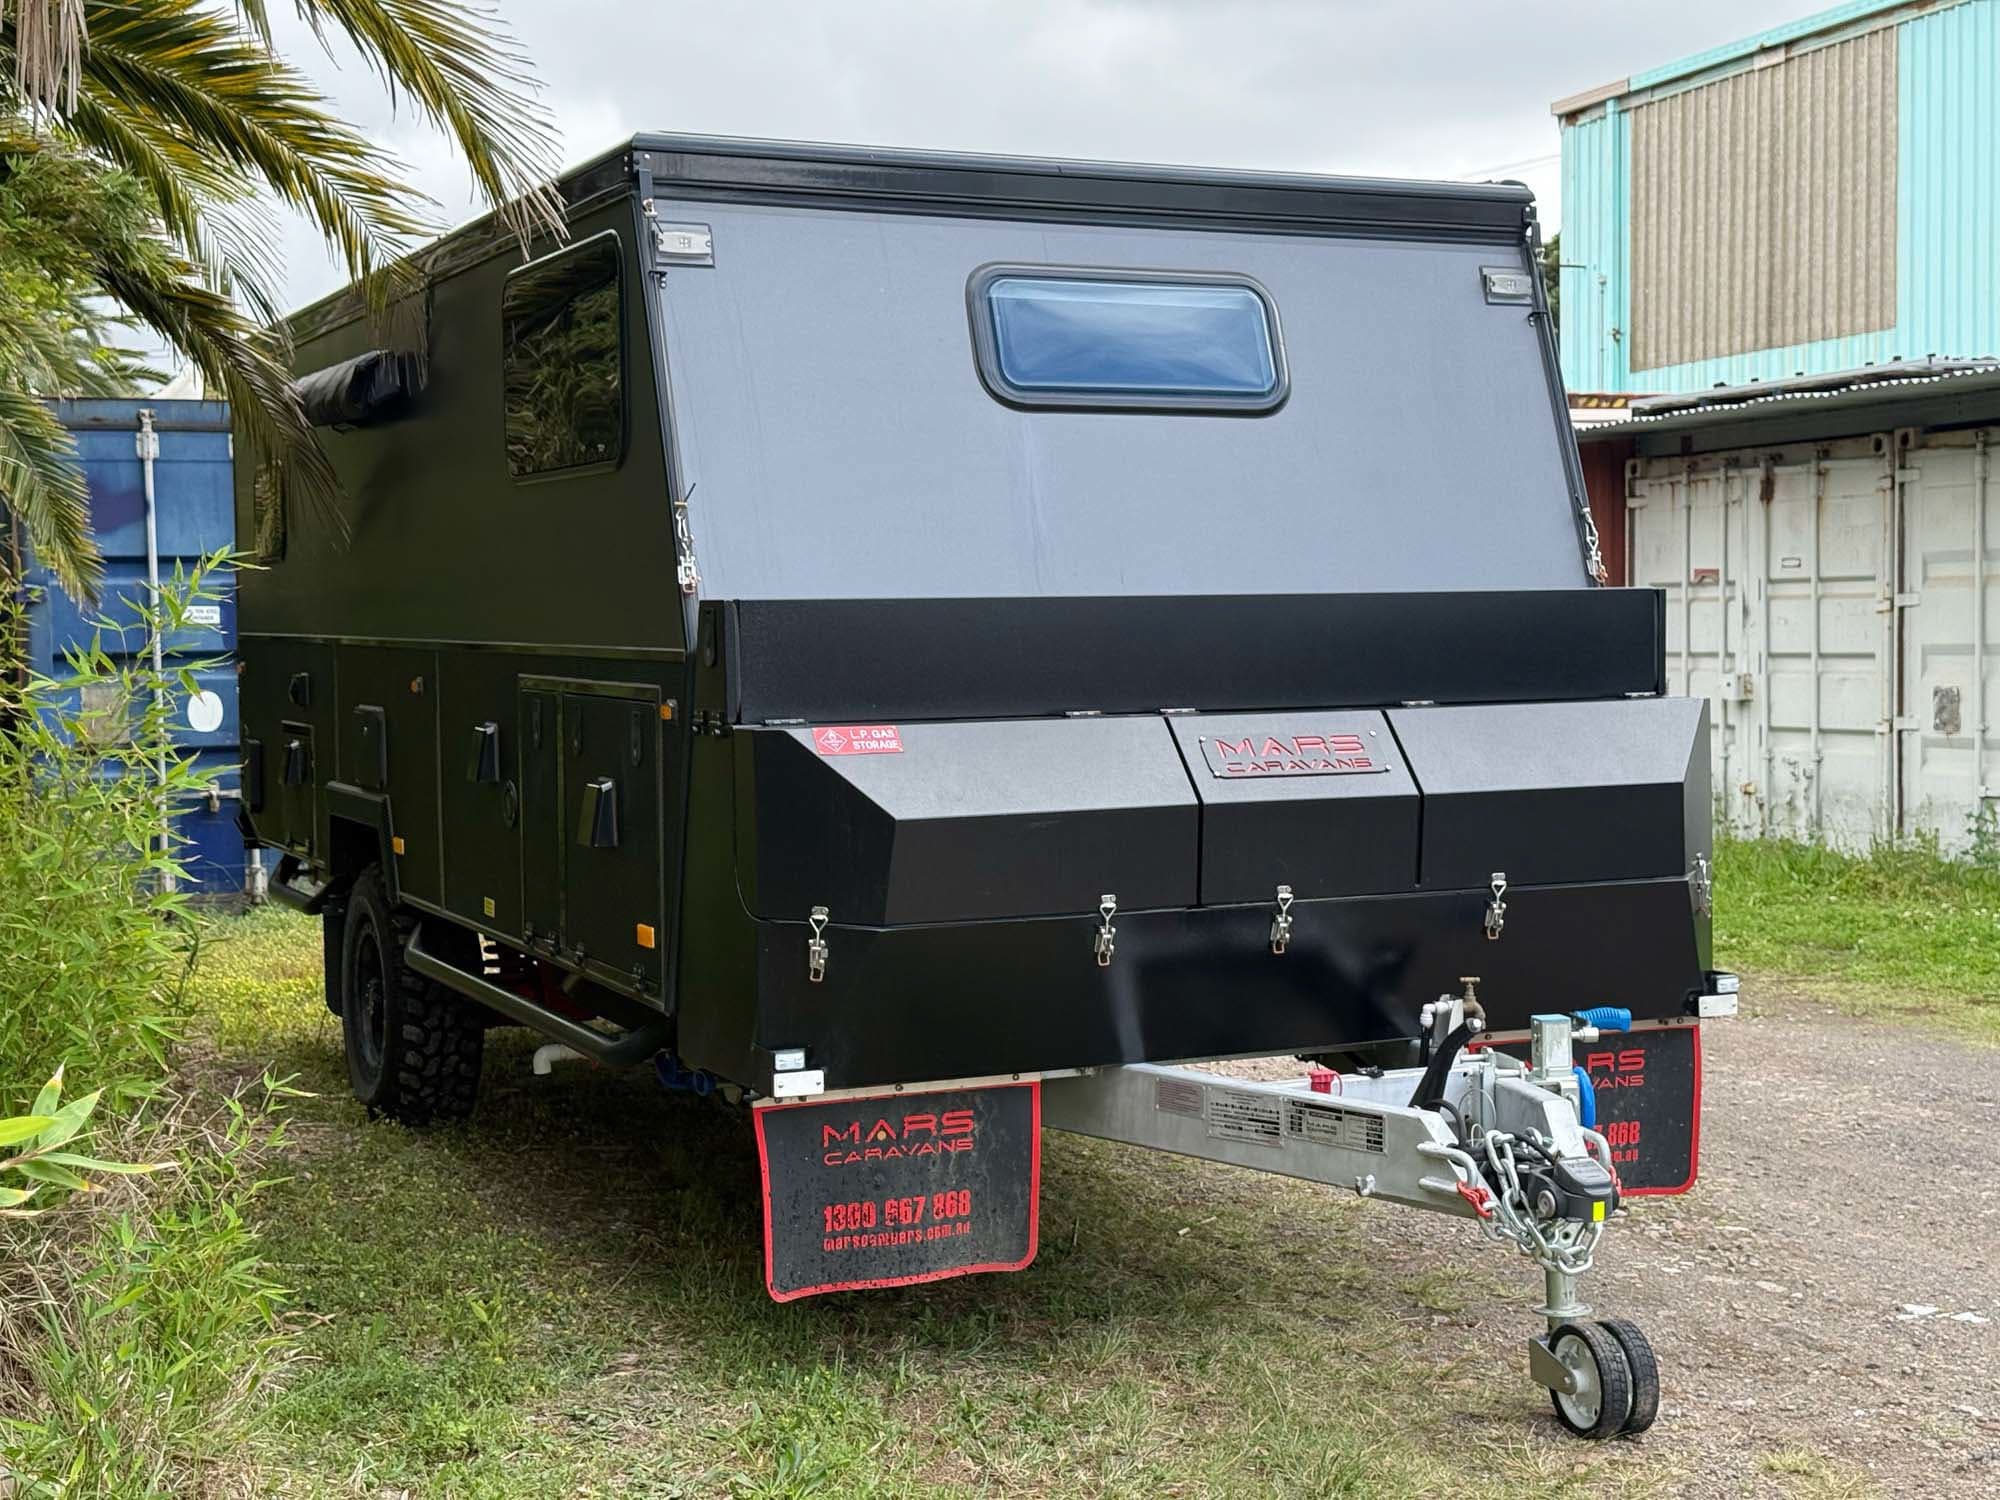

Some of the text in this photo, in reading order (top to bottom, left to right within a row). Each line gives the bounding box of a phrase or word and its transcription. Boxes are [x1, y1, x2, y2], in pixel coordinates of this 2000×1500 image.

[852, 740, 899, 750] STORAGE
[871, 729, 895, 739] GAS
[1215, 735, 1365, 758] MARS
[1226, 758, 1372, 773] CARAVANS
[823, 1109, 974, 1148] MARS
[1607, 1121, 1640, 1146] 868
[823, 1138, 974, 1166] CARAVANS
[823, 1201, 876, 1233] 1300
[932, 1189, 972, 1220] 868
